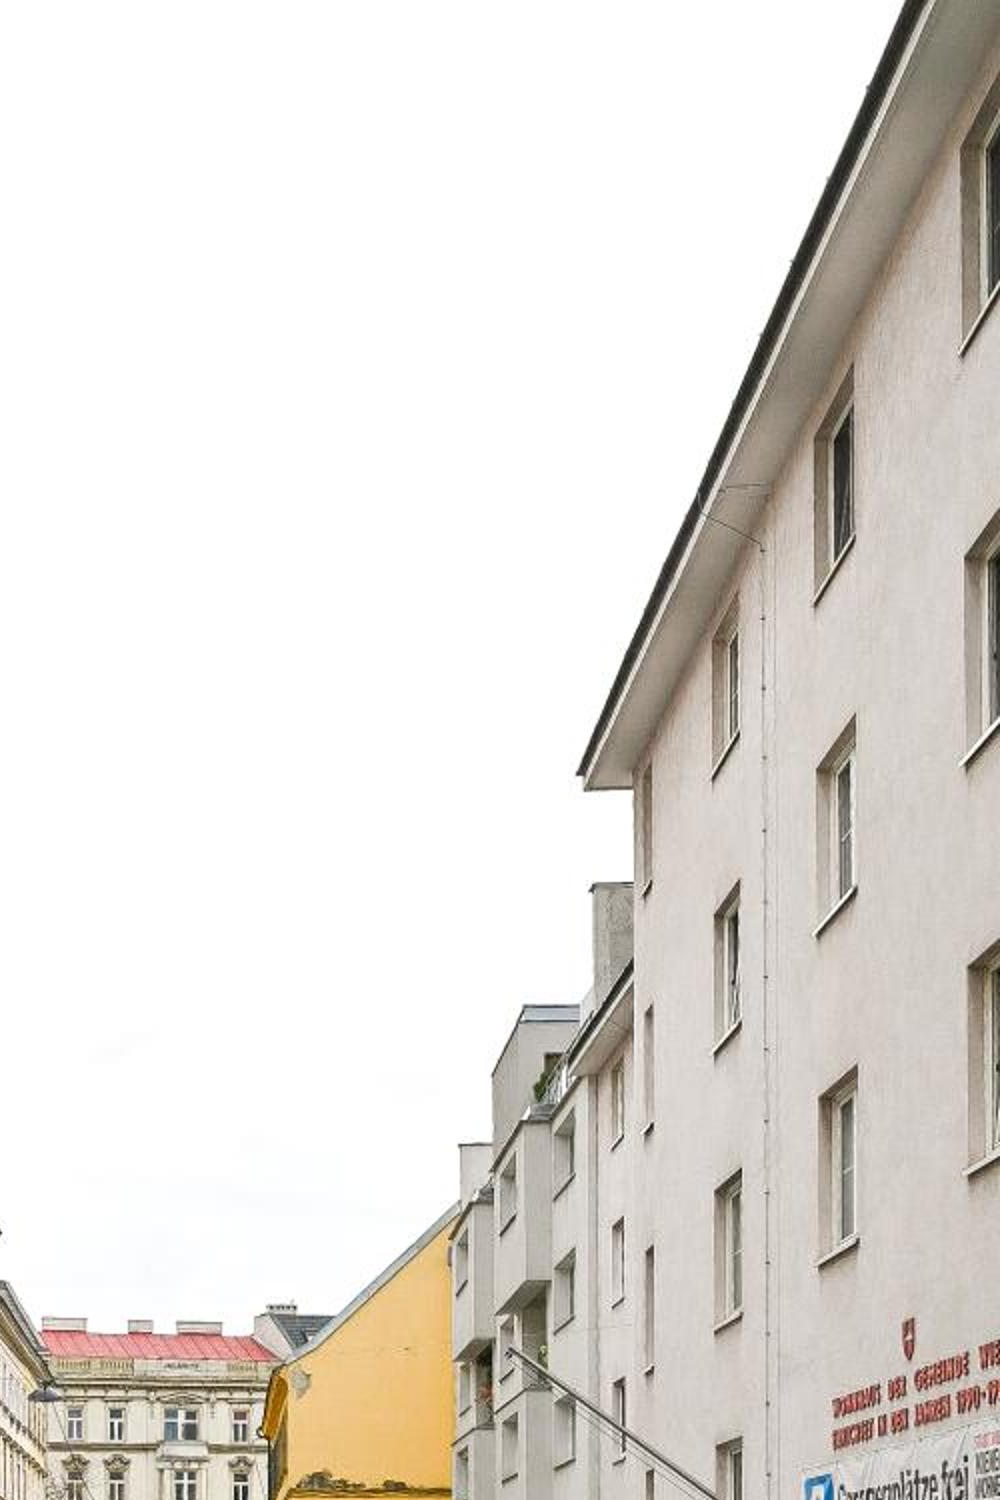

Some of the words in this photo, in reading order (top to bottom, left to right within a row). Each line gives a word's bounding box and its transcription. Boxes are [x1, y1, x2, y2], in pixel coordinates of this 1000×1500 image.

[888, 1376, 907, 1401] DER
[914, 1350, 970, 1392] GEMEINDE
[878, 1413, 887, 1438] IN
[890, 1408, 909, 1435] DEN
[914, 1395, 951, 1427] JAHREN
[956, 1379, 1000, 1414] 1990-19
